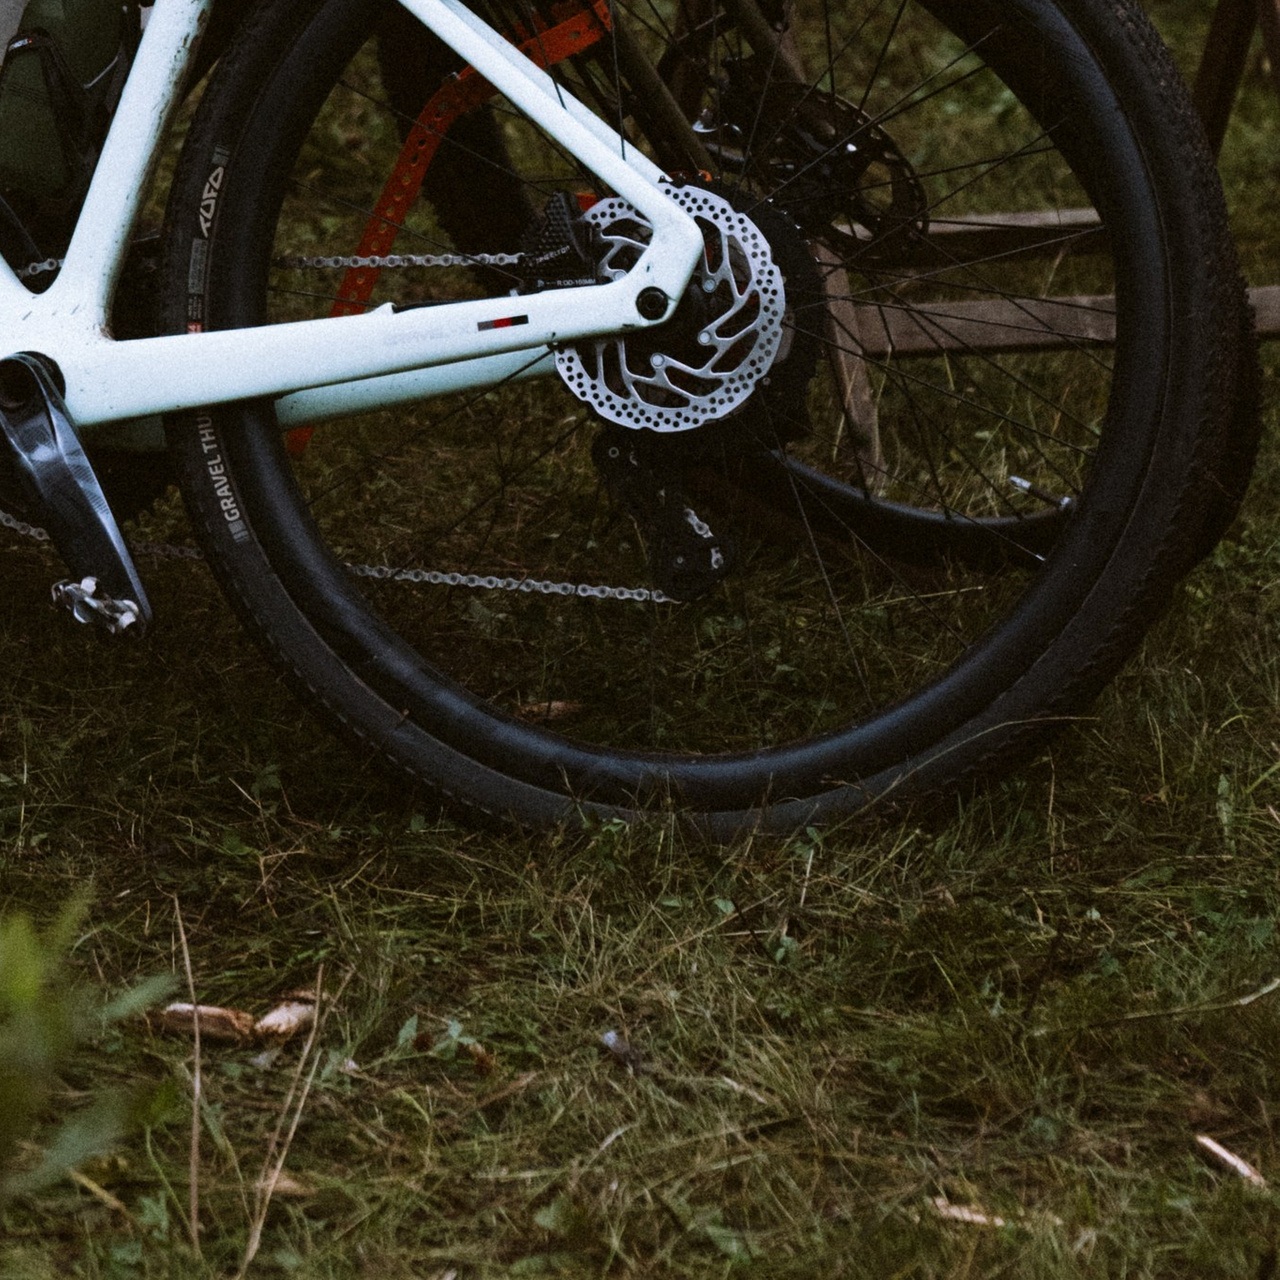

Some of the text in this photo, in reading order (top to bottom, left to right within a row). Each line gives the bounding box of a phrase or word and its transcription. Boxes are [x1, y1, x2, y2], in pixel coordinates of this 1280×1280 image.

[199, 166, 225, 238] TUFO
[197, 413, 240, 522] GRAVEL THU
